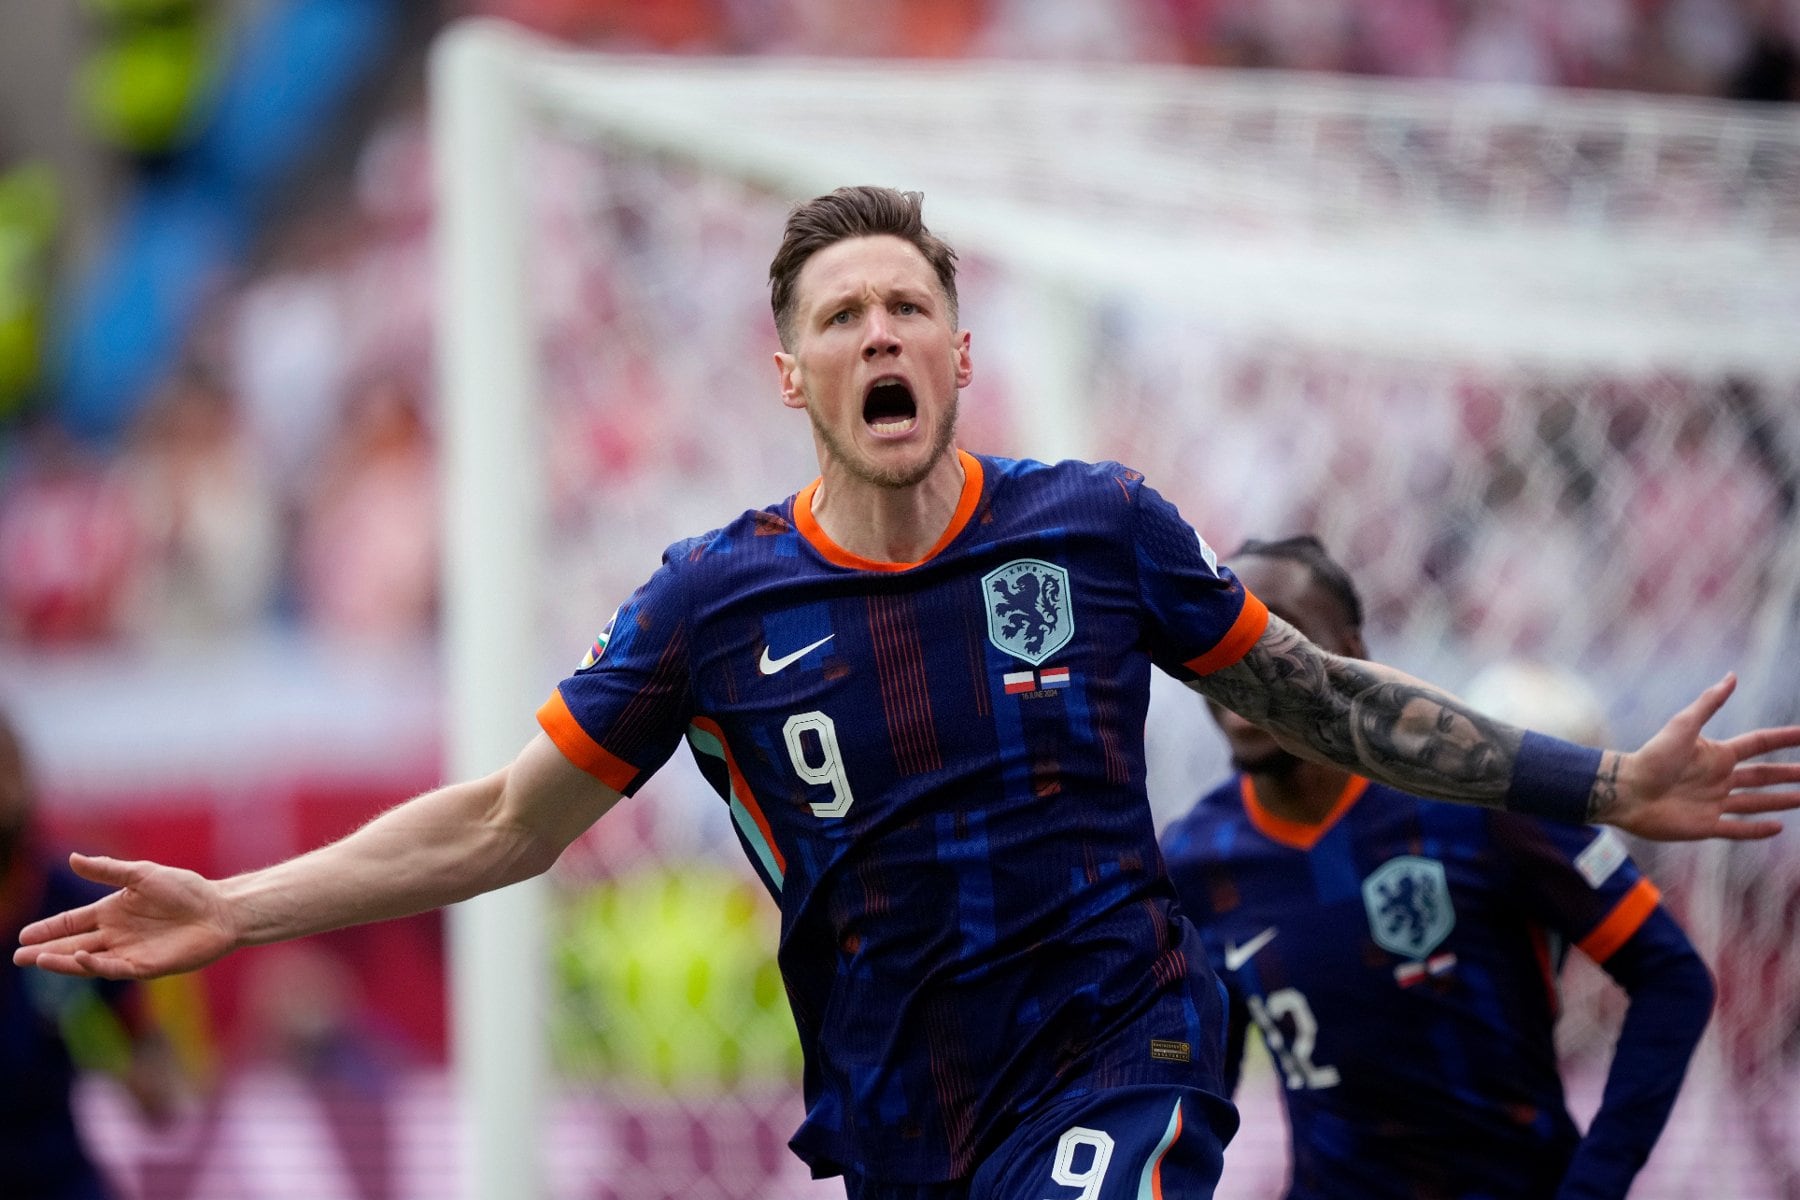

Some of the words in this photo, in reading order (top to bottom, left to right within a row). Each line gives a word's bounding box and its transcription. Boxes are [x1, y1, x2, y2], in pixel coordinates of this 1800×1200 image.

[1021, 692, 1029, 700] 16
[782, 710, 854, 818] 9
[1247, 986, 1341, 1090] 12
[1051, 1126, 1115, 1200] 9
